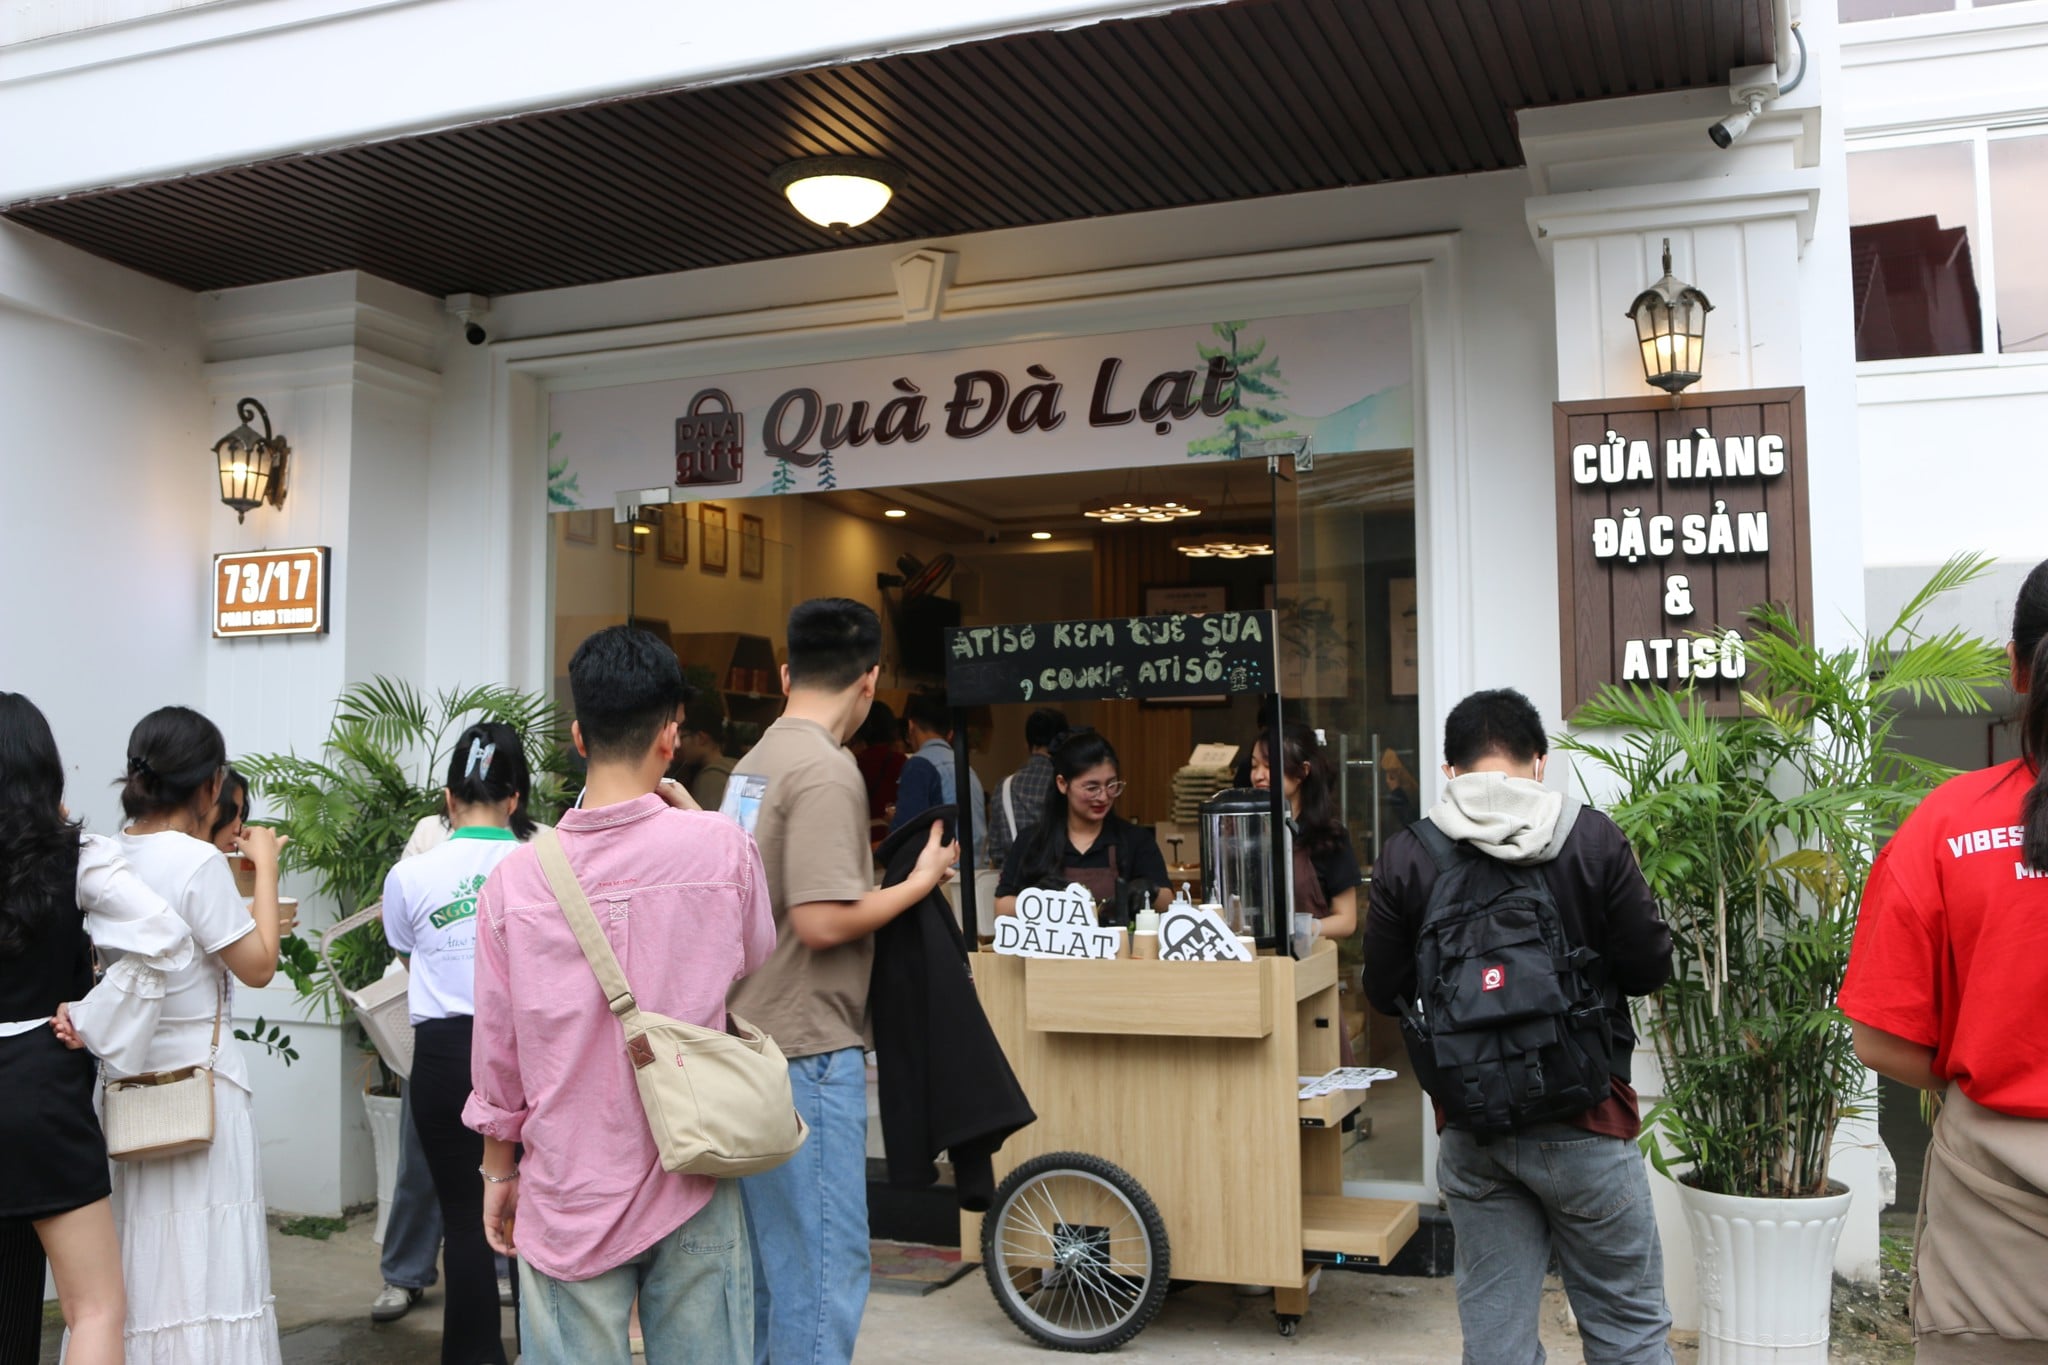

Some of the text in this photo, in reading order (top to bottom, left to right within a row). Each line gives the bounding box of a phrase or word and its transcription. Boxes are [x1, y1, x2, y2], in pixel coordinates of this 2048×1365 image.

[680, 420, 737, 441] DALA
[762, 355, 1239, 468] Quà Đà Lạt
[676, 440, 743, 485] gift
[1573, 427, 1785, 484] CỬA HÀNG
[1592, 500, 1769, 564] ĐẶC SẢN
[224, 559, 312, 604] 73/17
[1664, 574, 1695, 616] &
[1054, 622, 1115, 648] KEM
[1622, 629, 1747, 681] ATISÔ
[1946, 825, 2025, 858] VIBES
[1022, 890, 1091, 926] QUÀ
